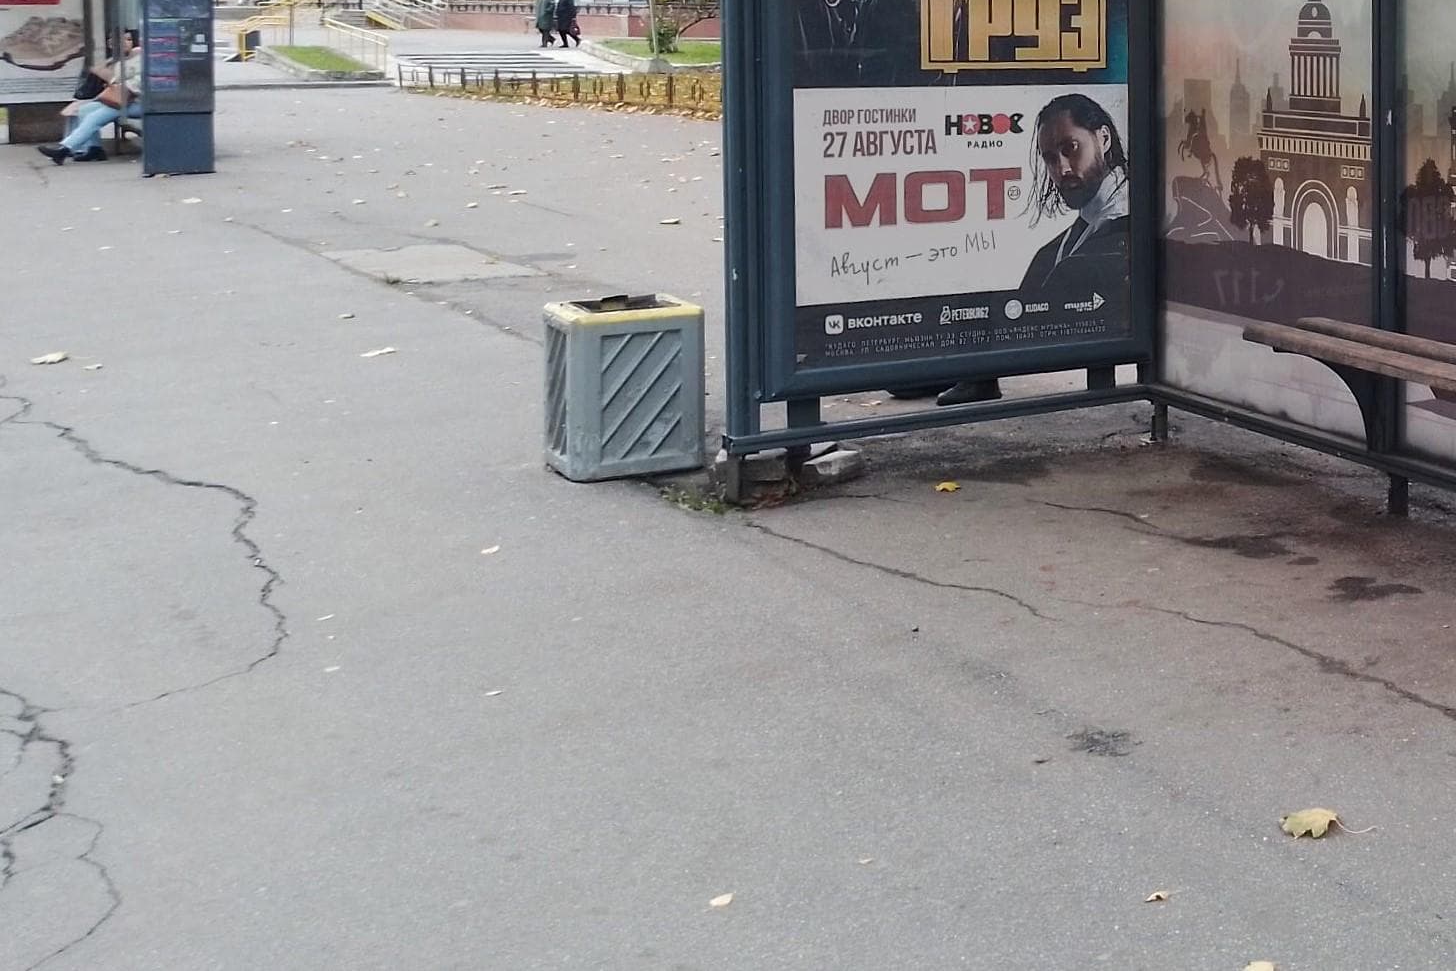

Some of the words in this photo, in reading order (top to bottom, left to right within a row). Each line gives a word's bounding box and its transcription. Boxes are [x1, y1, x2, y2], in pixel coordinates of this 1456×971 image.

[823, 109, 855, 127] ДВОР
[857, 108, 916, 125] ГОСТИНКИ
[823, 132, 847, 158] 27
[852, 129, 937, 157] АВГУСТА
[967, 140, 1003, 149] РАДИО
[824, 167, 1022, 229] МОТ
[830, 252, 900, 286] Август
[928, 245, 958, 262] это
[1025, 302, 1049, 313] KUDAGO
[1064, 301, 1093, 310] music
